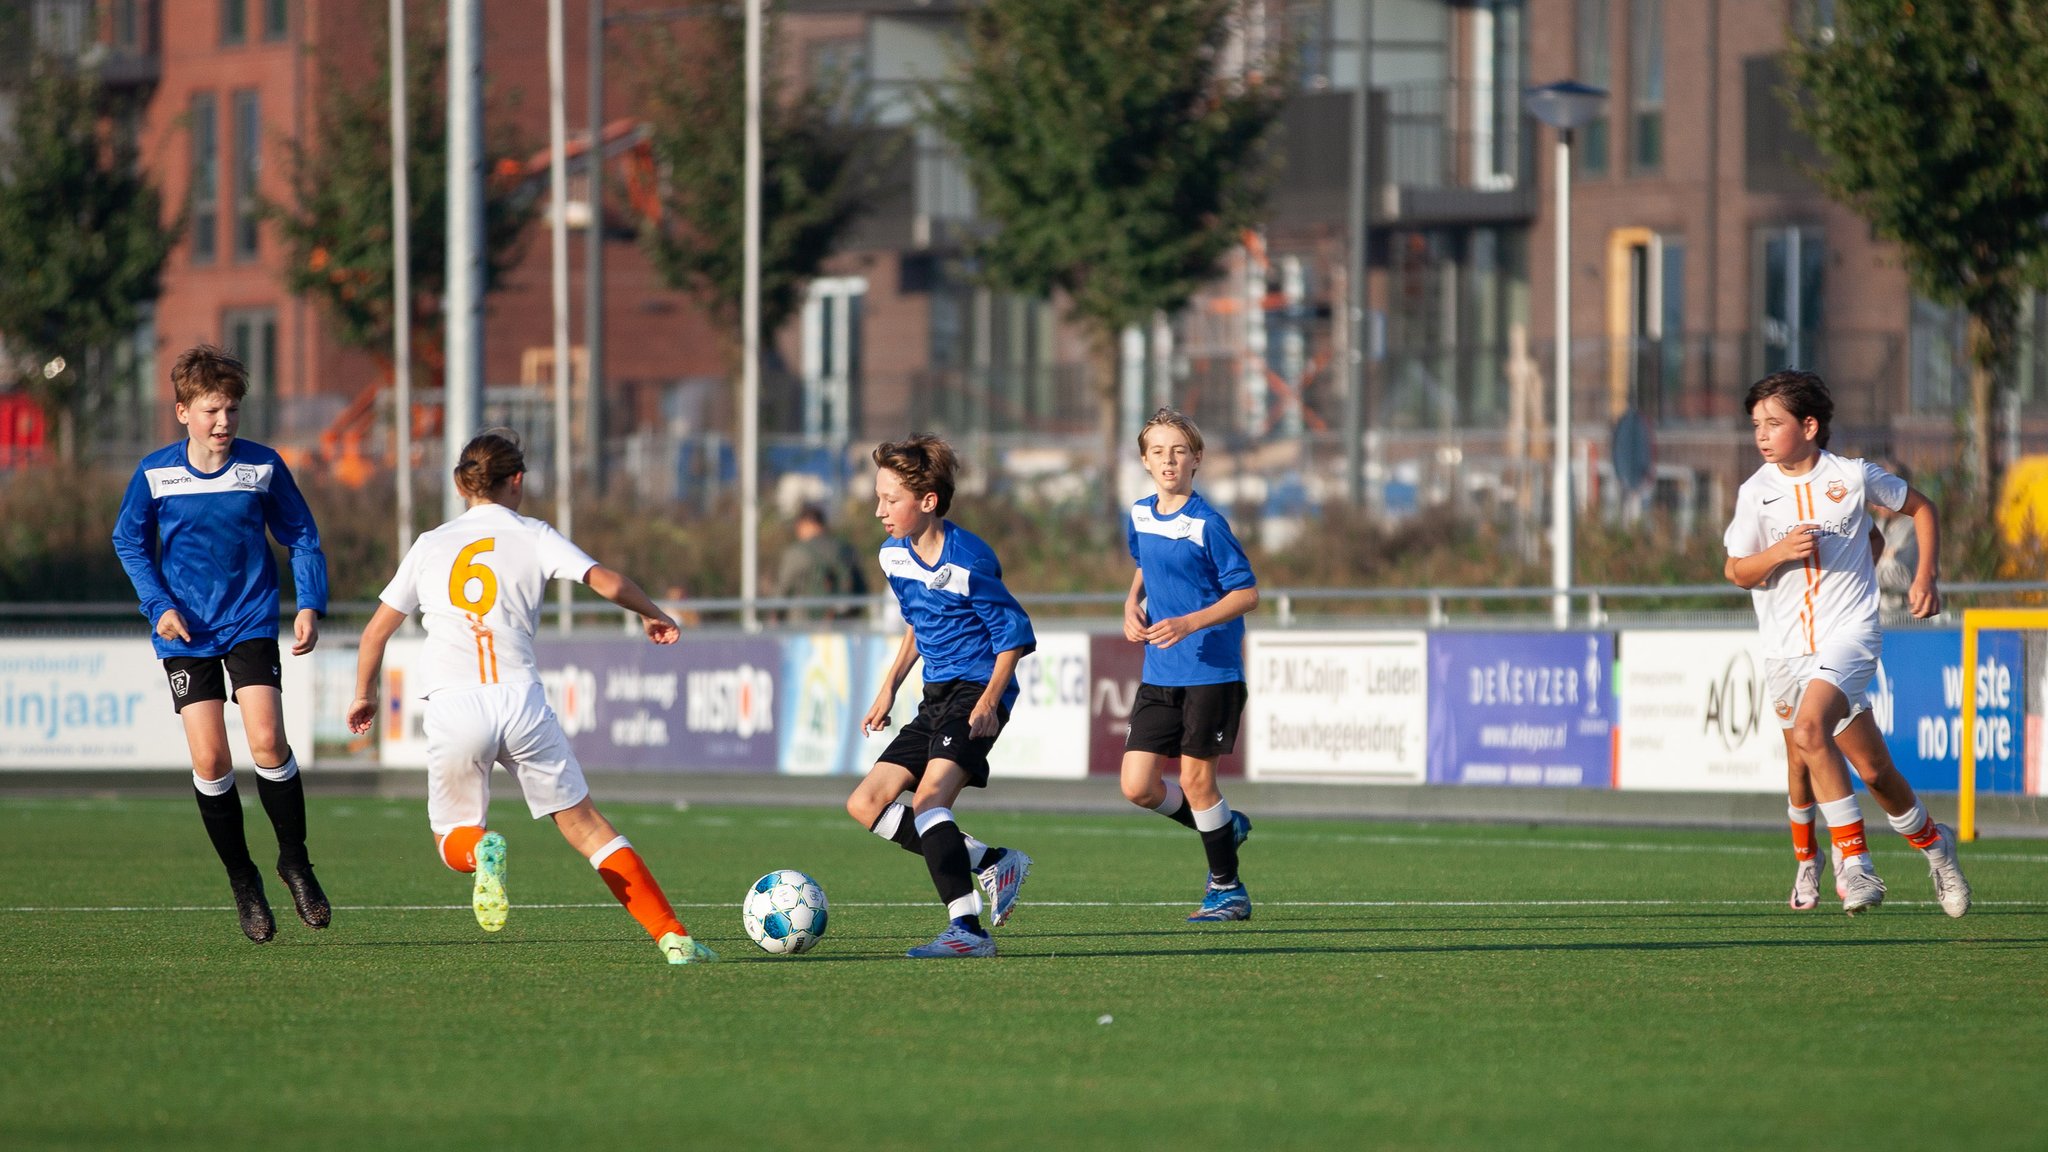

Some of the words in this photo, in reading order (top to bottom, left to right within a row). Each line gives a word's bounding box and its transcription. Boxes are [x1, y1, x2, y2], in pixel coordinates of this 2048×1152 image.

[162, 476, 191, 486] macron
[449, 537, 498, 617] 6
[541, 664, 597, 738] TOR
[686, 664, 774, 740] HISTOR
[1367, 658, 1420, 695] Leiden
[1942, 656, 2011, 709] wste
[1269, 713, 1406, 762] Bouwbegeleiding
[1918, 715, 1948, 761] no
